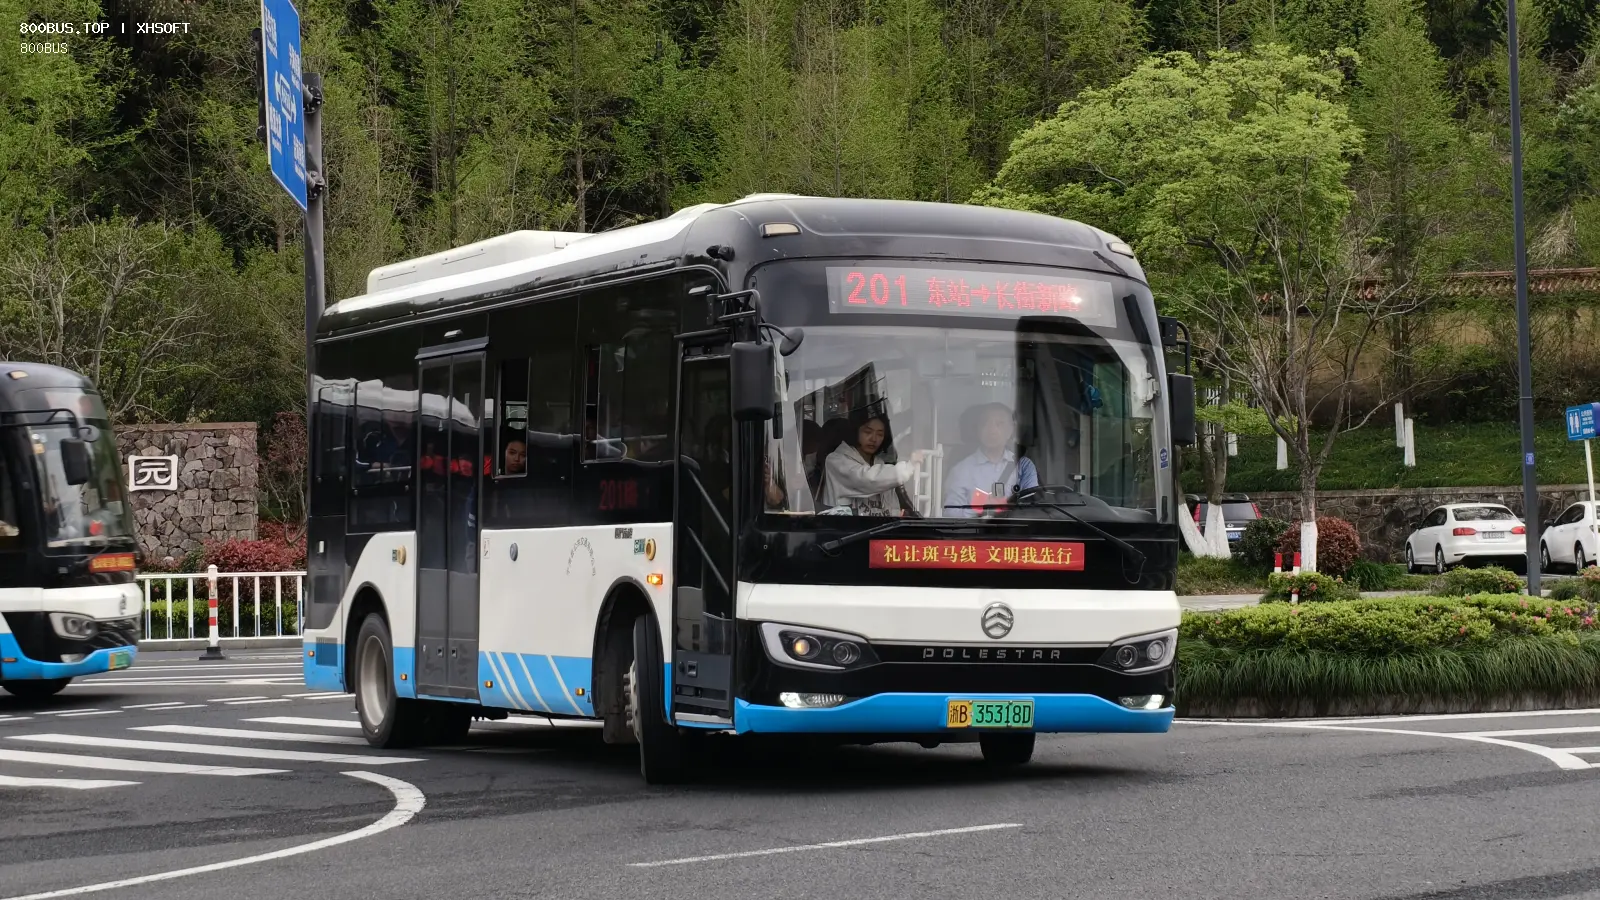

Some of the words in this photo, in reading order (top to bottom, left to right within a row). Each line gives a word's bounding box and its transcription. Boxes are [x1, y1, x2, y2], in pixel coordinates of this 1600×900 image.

[846, 272, 908, 306] 201
[128, 454, 178, 491] 园
[883, 544, 977, 563] 礼让斑马线
[985, 546, 1072, 565] 文明我先行
[922, 648, 1061, 659] POLESTAR
